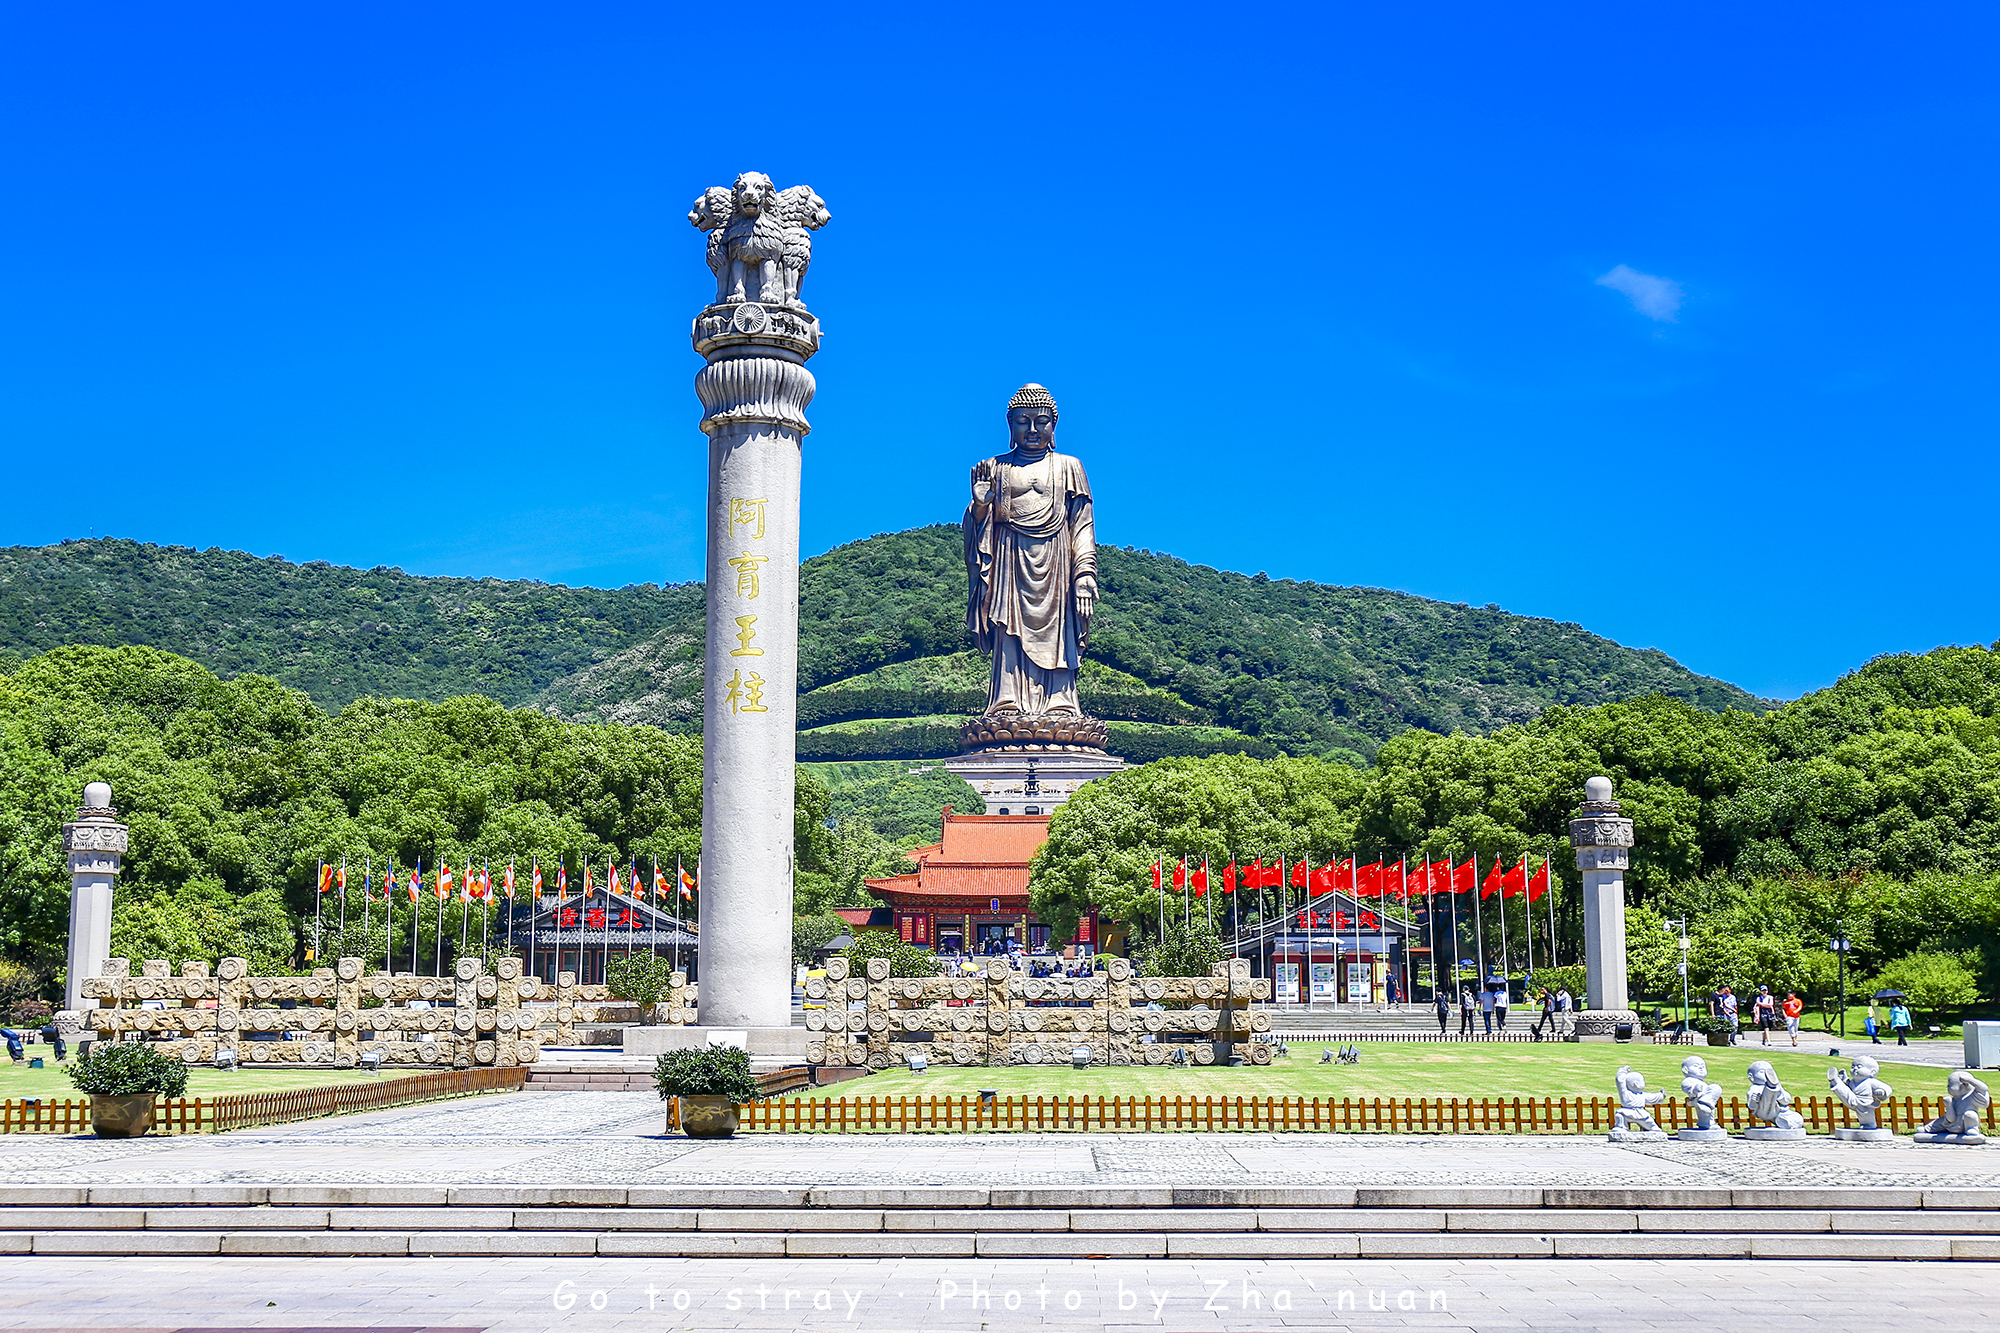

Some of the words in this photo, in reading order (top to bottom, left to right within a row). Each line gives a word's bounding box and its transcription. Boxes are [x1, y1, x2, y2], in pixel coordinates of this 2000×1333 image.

[724, 496, 769, 716] 阿育王柱
[1296, 910, 1381, 930] 请香处
